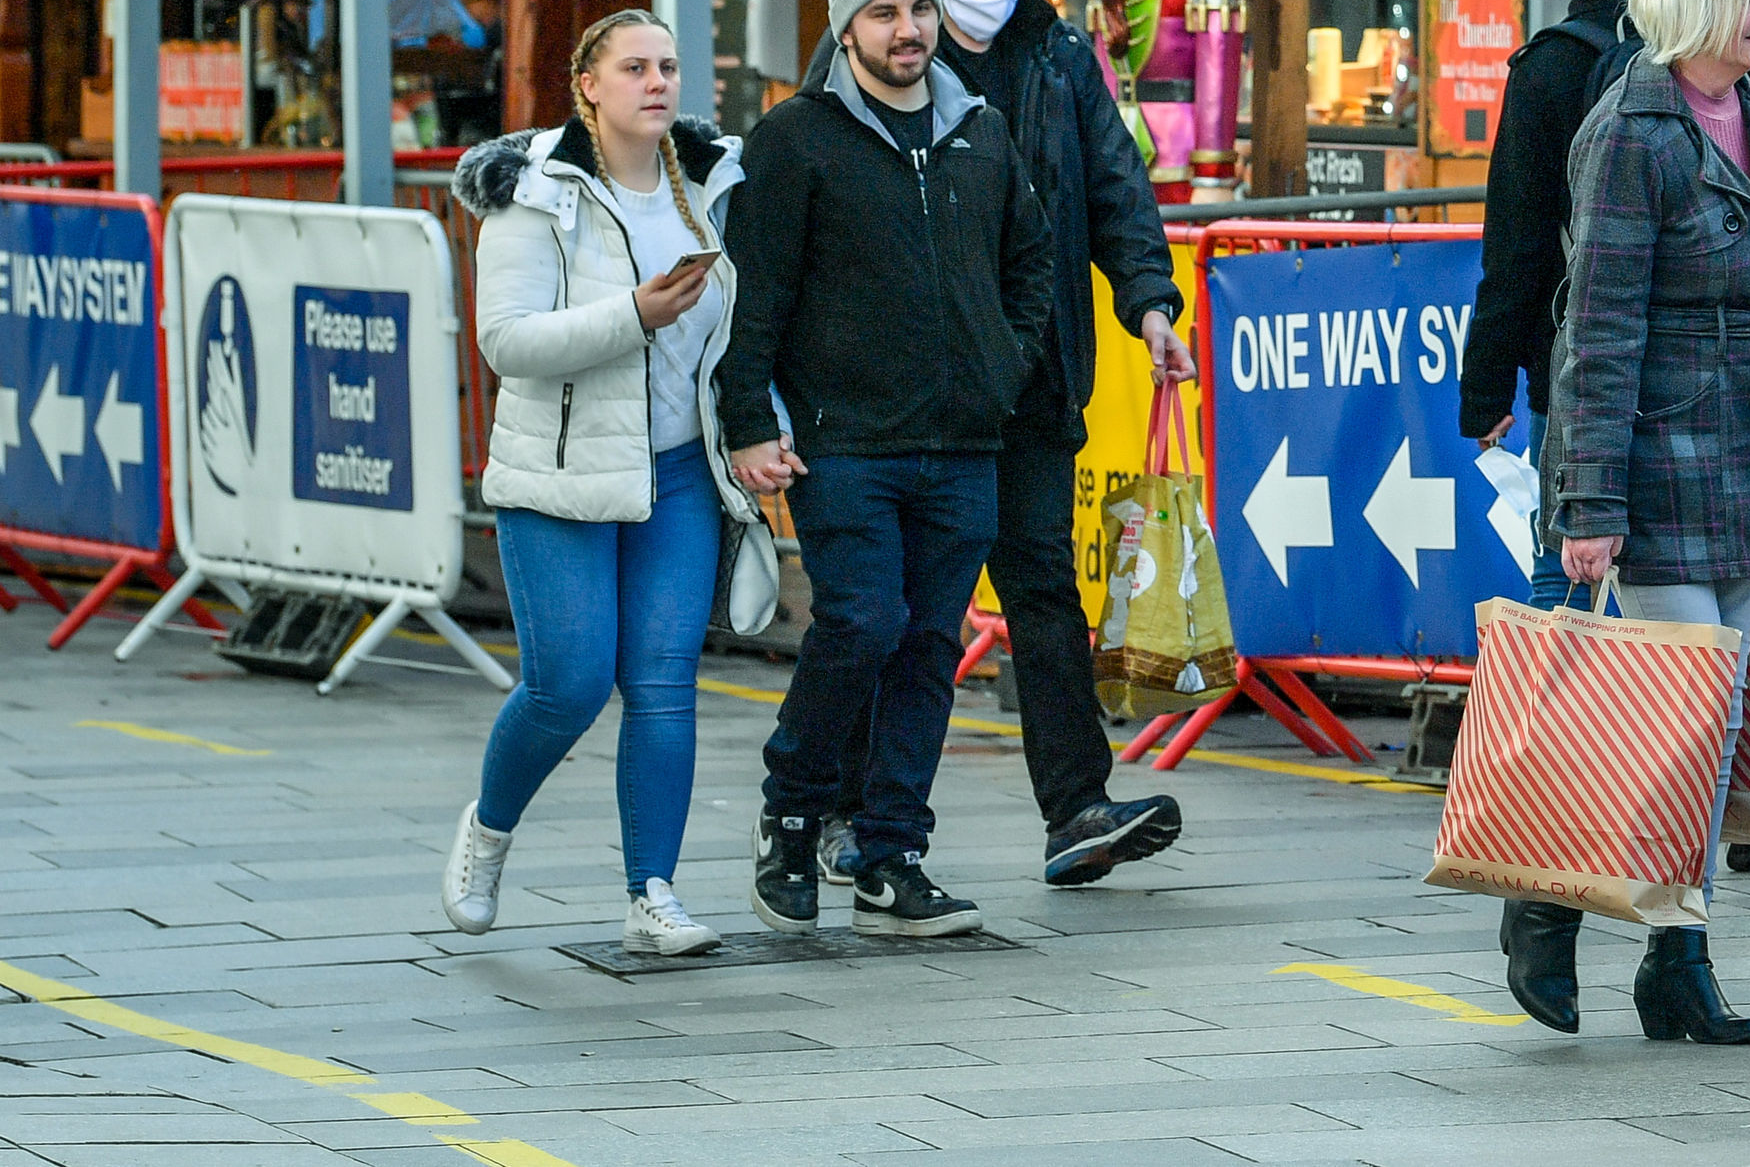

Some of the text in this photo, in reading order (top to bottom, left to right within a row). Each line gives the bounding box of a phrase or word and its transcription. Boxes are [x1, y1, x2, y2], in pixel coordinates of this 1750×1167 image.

[12, 254, 58, 320] WAY
[58, 257, 146, 326] SYSTEM
[304, 299, 397, 353] Please use
[1232, 313, 1310, 393] ONE
[1319, 307, 1408, 387] WAY
[328, 372, 376, 422] hand
[315, 444, 393, 495] sanitiser
[1501, 606, 1539, 624] THIS BAG
[1571, 617, 1646, 636] WRAPPING PAPER
